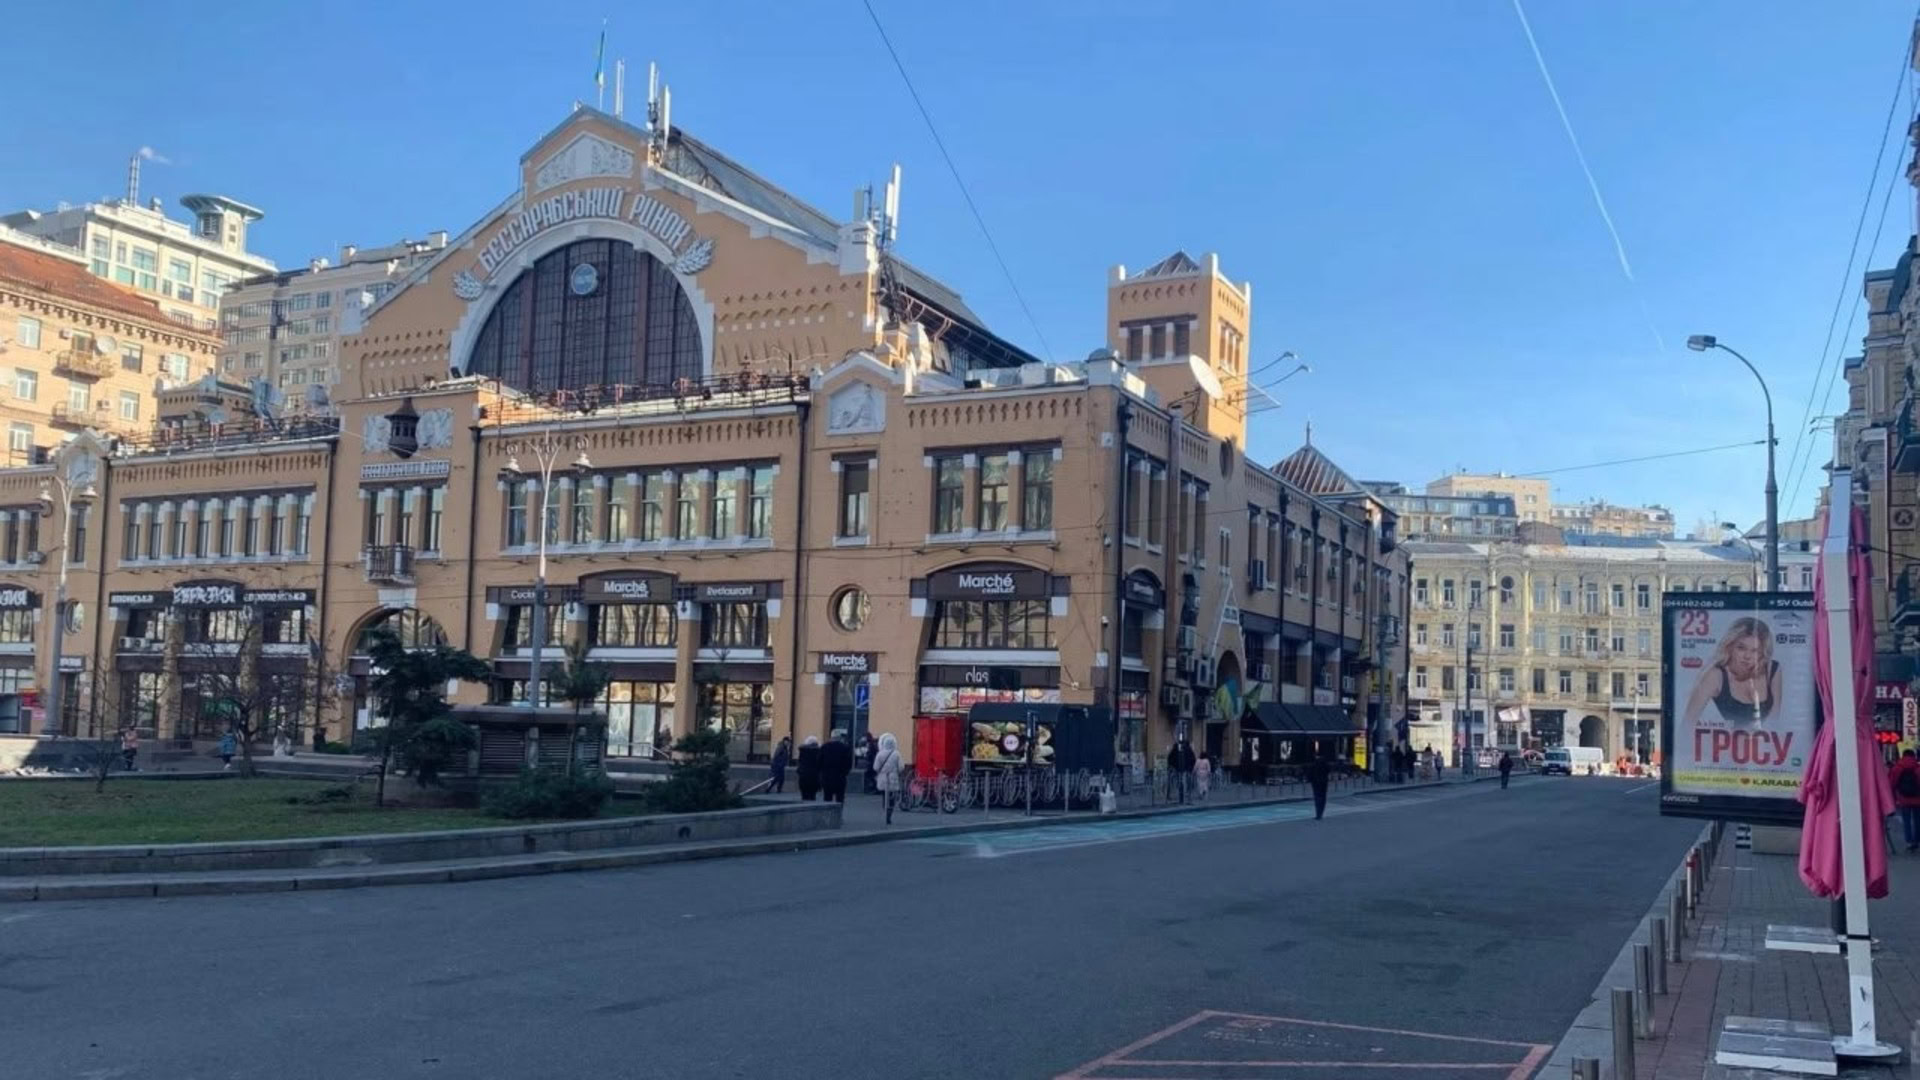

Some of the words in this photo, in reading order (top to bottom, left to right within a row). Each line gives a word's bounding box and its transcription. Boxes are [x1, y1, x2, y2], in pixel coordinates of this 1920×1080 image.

[629, 194, 692, 250] РИНОК
[604, 580, 648, 593] Marché
[960, 573, 1013, 588] Marché
[1681, 610, 1710, 636] 23
[823, 654, 866, 666] Marché
[1694, 729, 1793, 766] ГРОСУ
